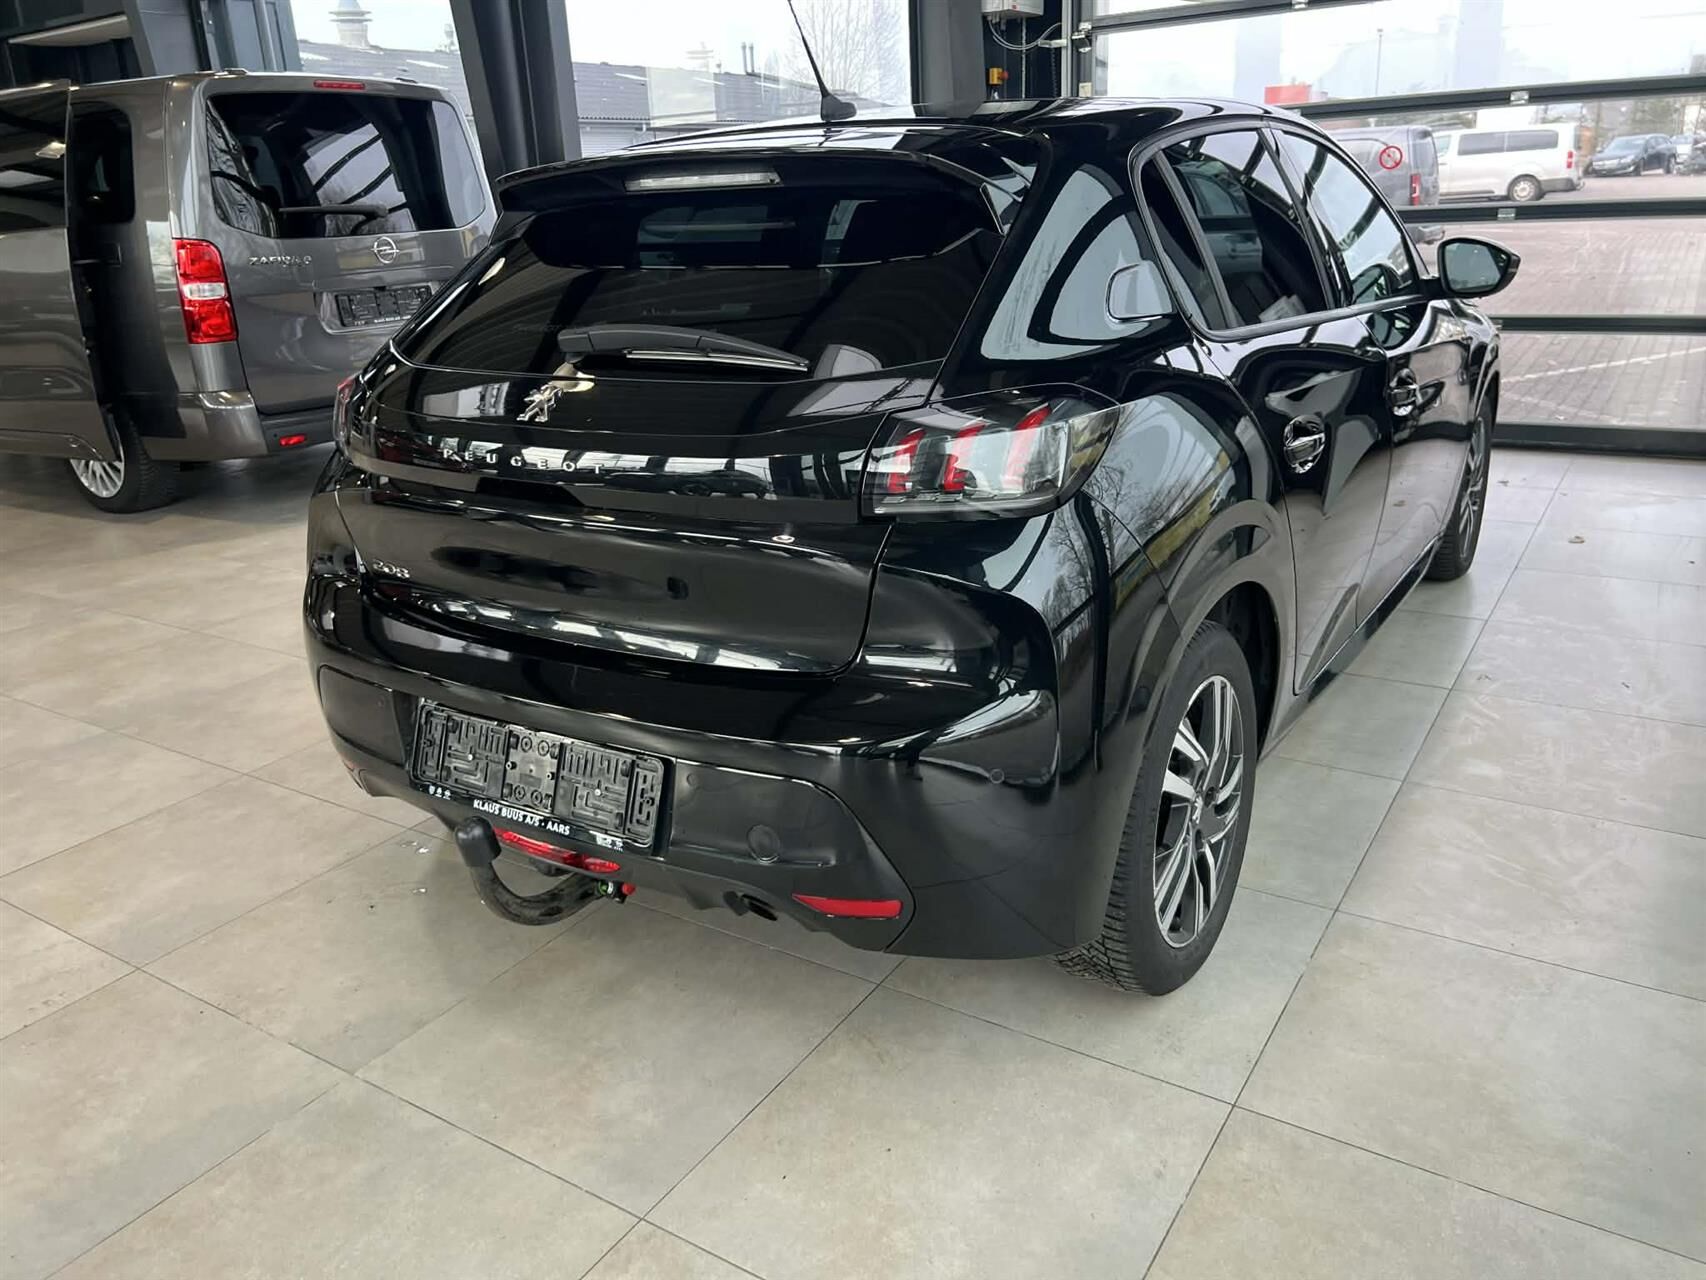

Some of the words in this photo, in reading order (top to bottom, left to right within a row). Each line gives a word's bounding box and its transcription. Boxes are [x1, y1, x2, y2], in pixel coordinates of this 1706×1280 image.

[442, 449, 603, 474] PEUGEOT
[473, 799, 500, 815] KLAUS
[501, 807, 523, 822] BUUS
[525, 815, 540, 827] A/S
[546, 821, 571, 836] AARS
